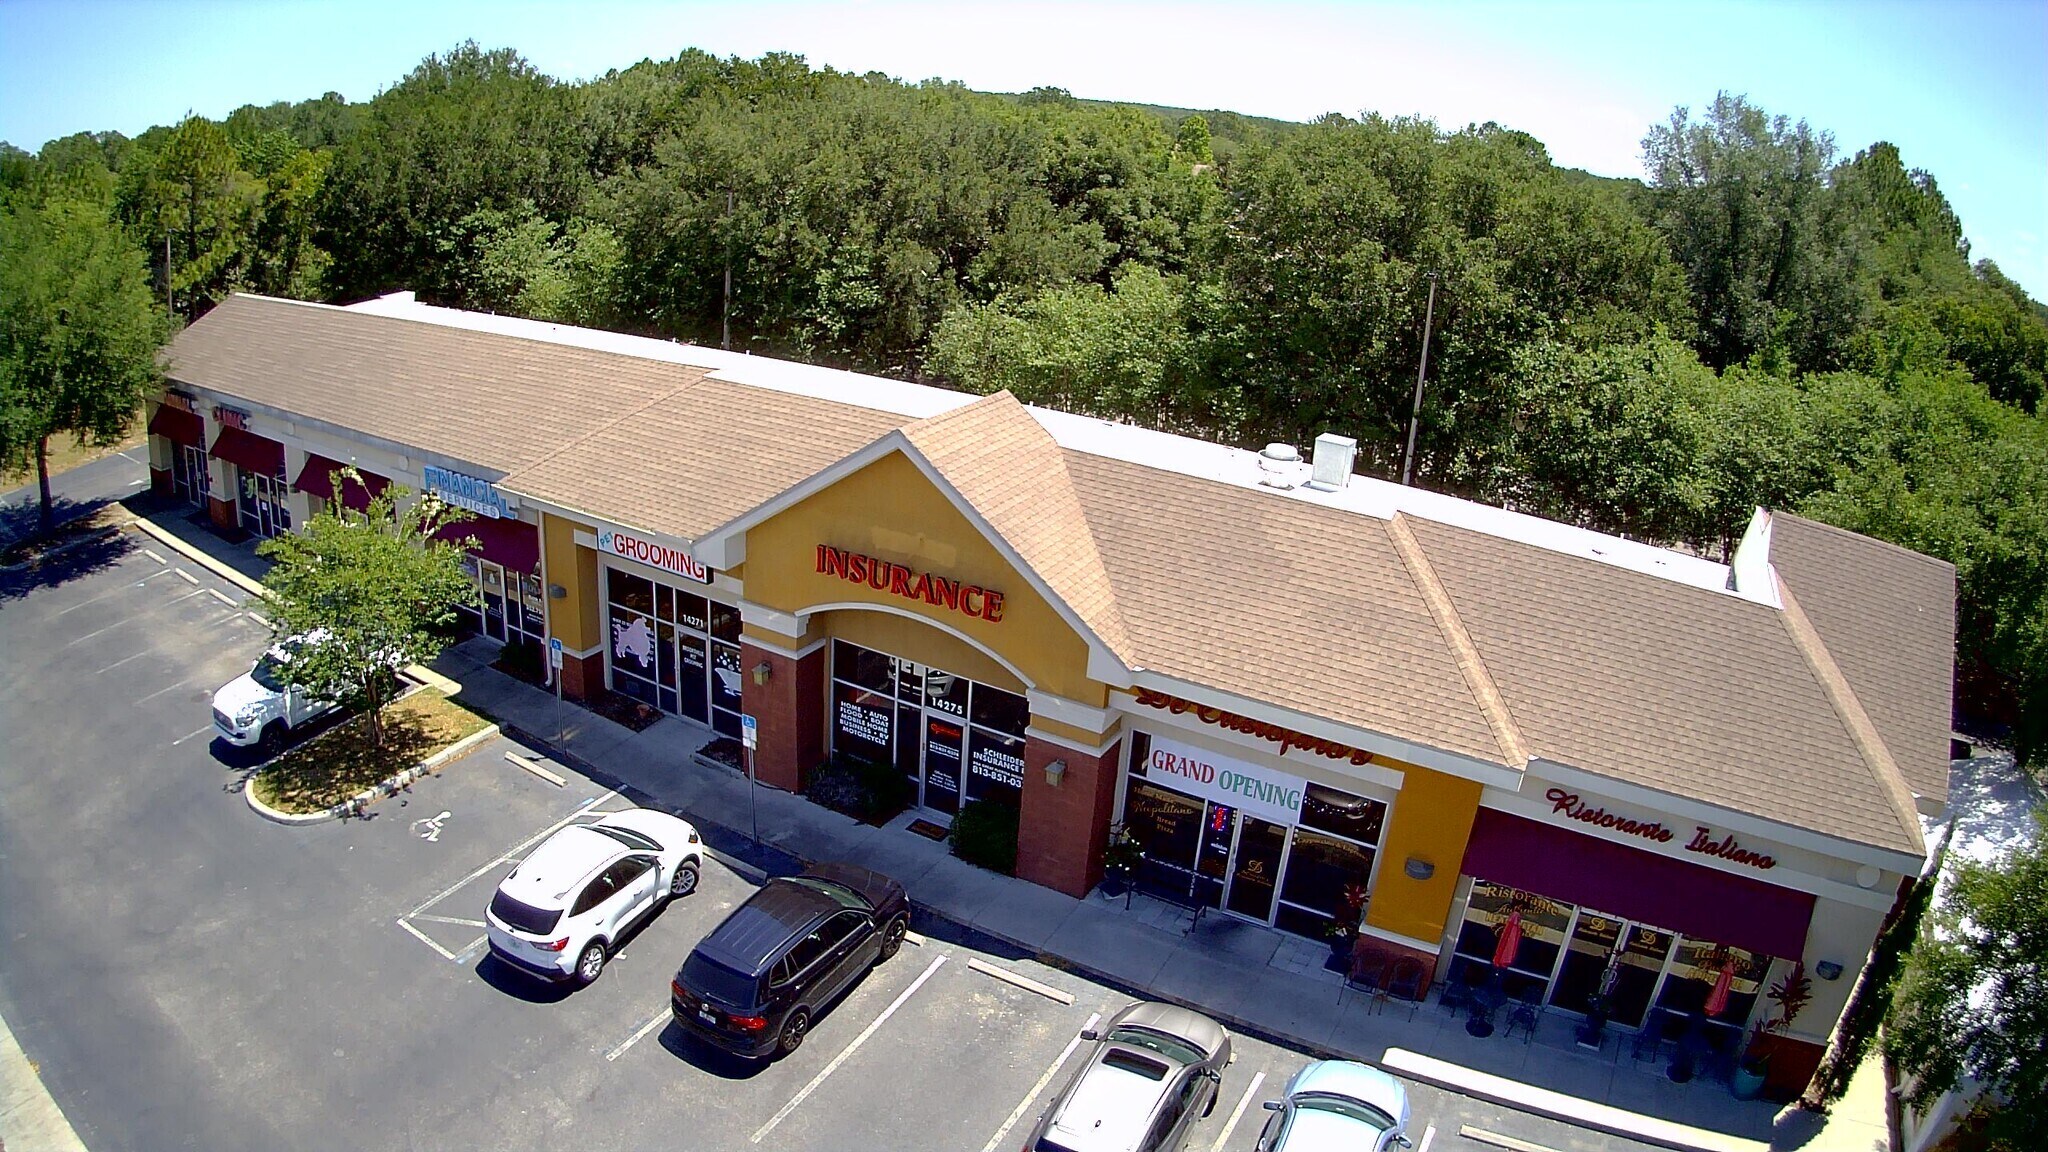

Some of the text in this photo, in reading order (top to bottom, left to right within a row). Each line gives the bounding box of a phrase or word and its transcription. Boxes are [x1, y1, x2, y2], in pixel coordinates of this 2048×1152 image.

[424, 464, 517, 520] FINANCIAL
[438, 489, 497, 517] SERVICES
[599, 531, 705, 580] PET GROOMING
[816, 543, 1005, 623] INSURANCE
[683, 613, 704, 628] 14271
[840, 700, 889, 722] HOME AUTO
[932, 696, 963, 715] 14275
[840, 706, 889, 728] FLOOD BOAT
[840, 713, 888, 735] MOBILE HOME
[840, 718, 889, 740] BUSINESS RV
[842, 725, 886, 746] MOTORCYCLE
[973, 751, 1020, 773] INSURANCE
[1152, 749, 1215, 784] GRAND
[1218, 769, 1300, 811] OPENING
[1546, 787, 1777, 870] Ristorante Italiano
[1484, 884, 1560, 917] Ristorante
